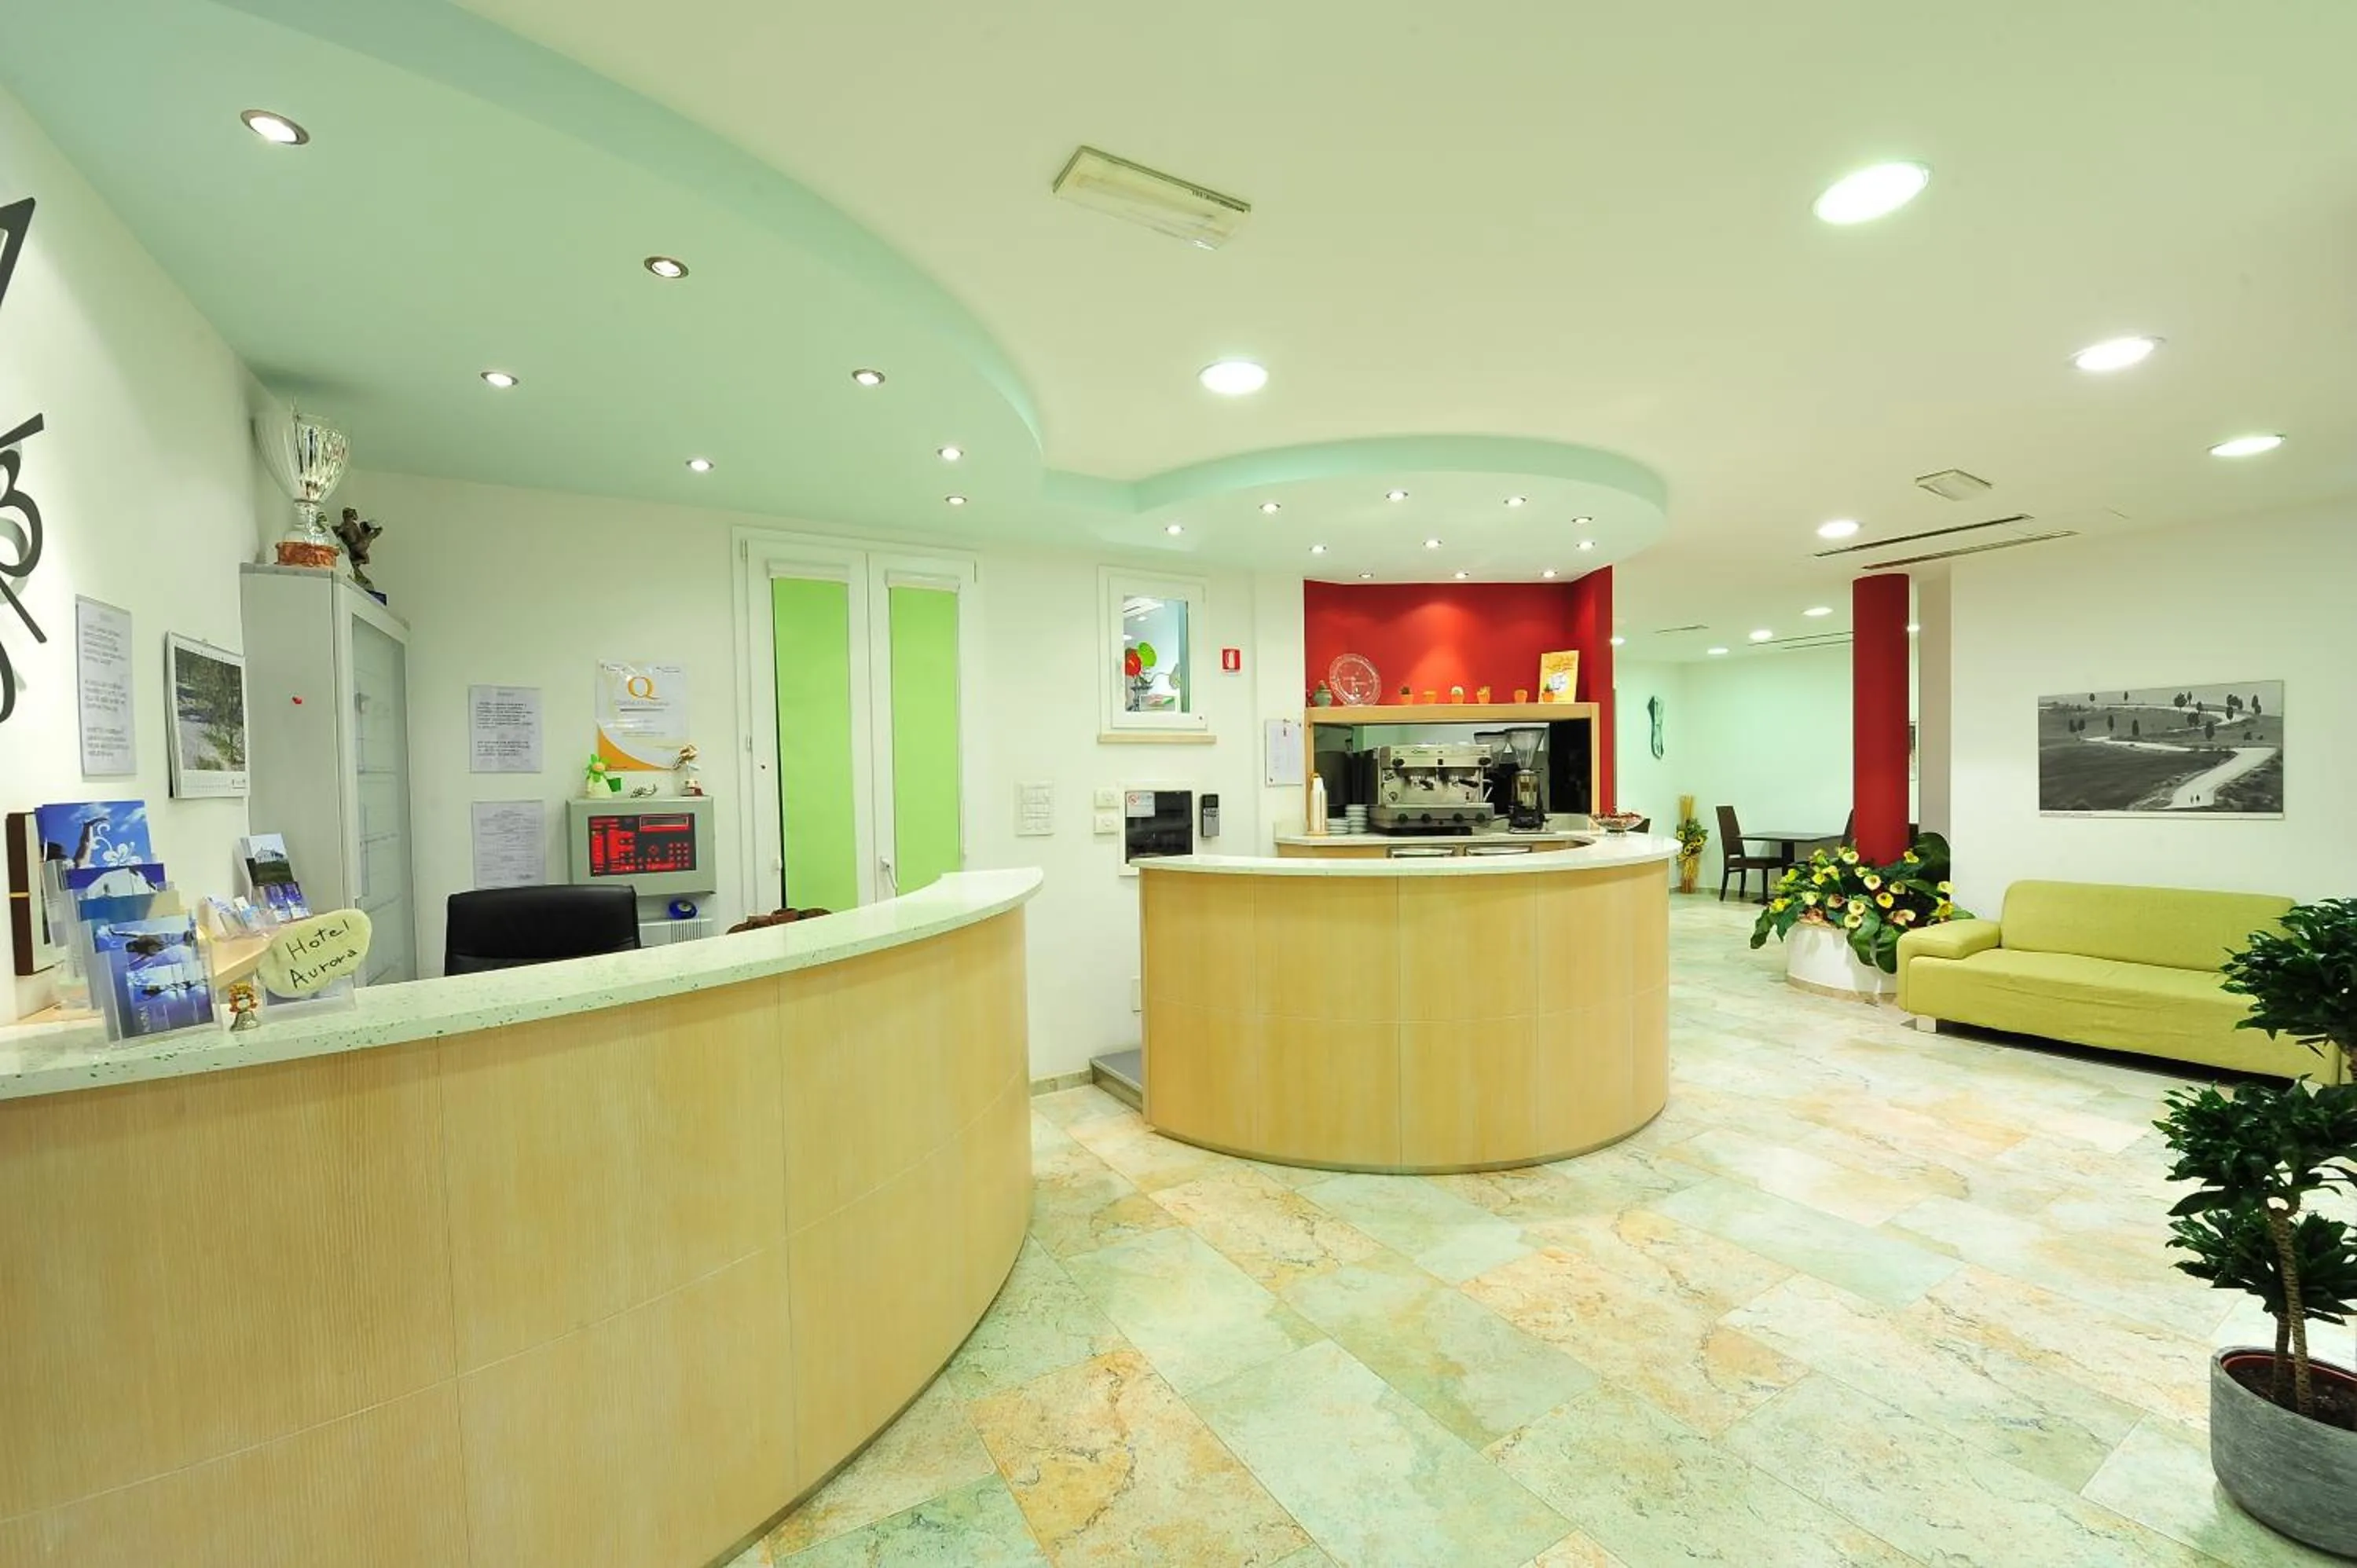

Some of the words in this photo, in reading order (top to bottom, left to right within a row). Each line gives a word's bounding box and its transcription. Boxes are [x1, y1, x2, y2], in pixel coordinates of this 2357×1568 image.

[628, 676, 660, 698] Q
[286, 919, 350, 962] Hotel
[289, 948, 358, 988] Aurora
